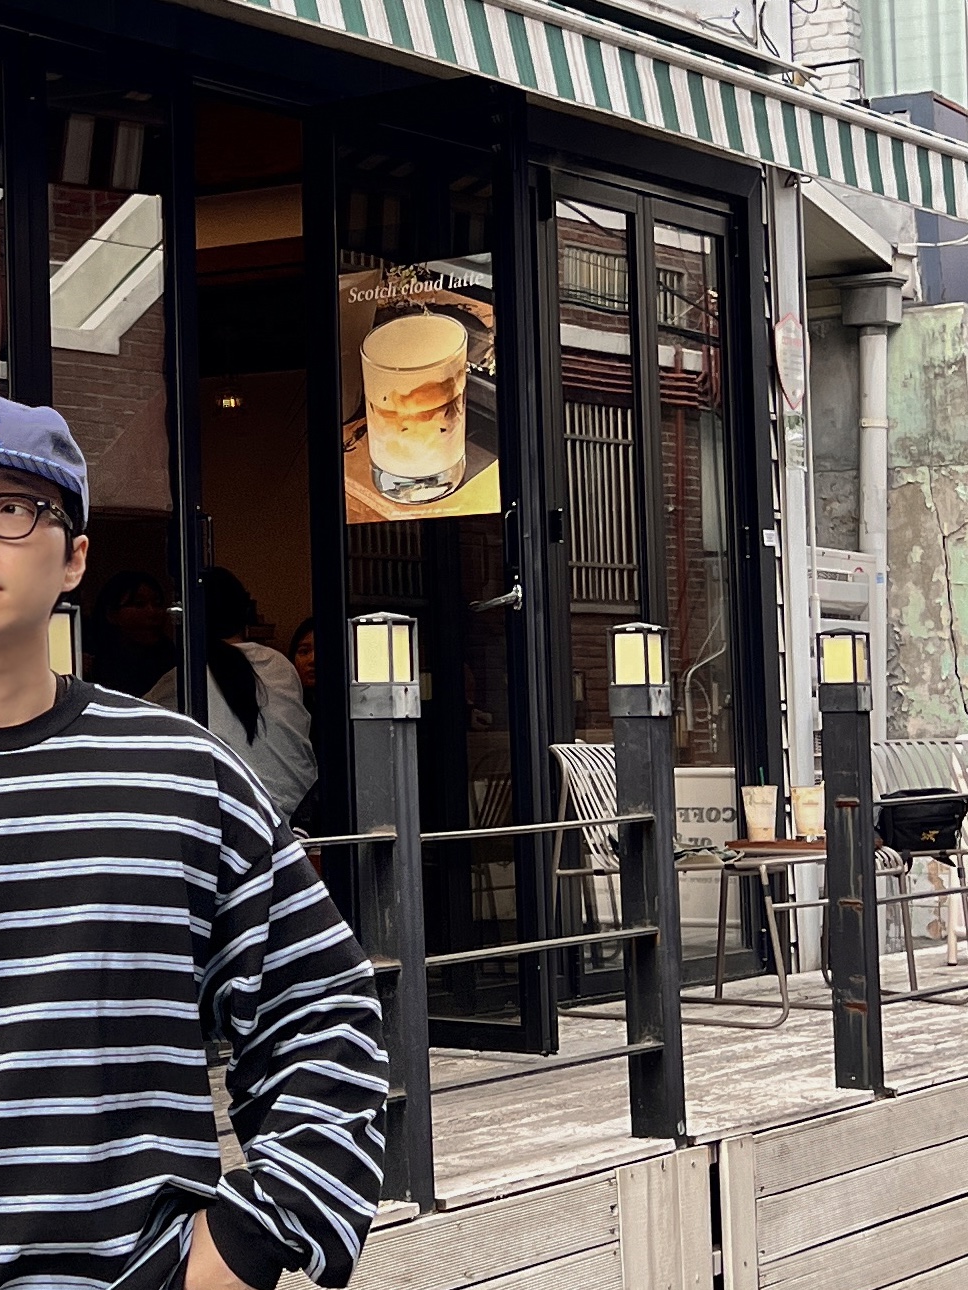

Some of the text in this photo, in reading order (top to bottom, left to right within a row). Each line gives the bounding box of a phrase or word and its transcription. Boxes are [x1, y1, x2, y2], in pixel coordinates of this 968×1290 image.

[348, 281, 396, 303] Scotch
[402, 274, 443, 295] cloud
[448, 272, 484, 289] latte
